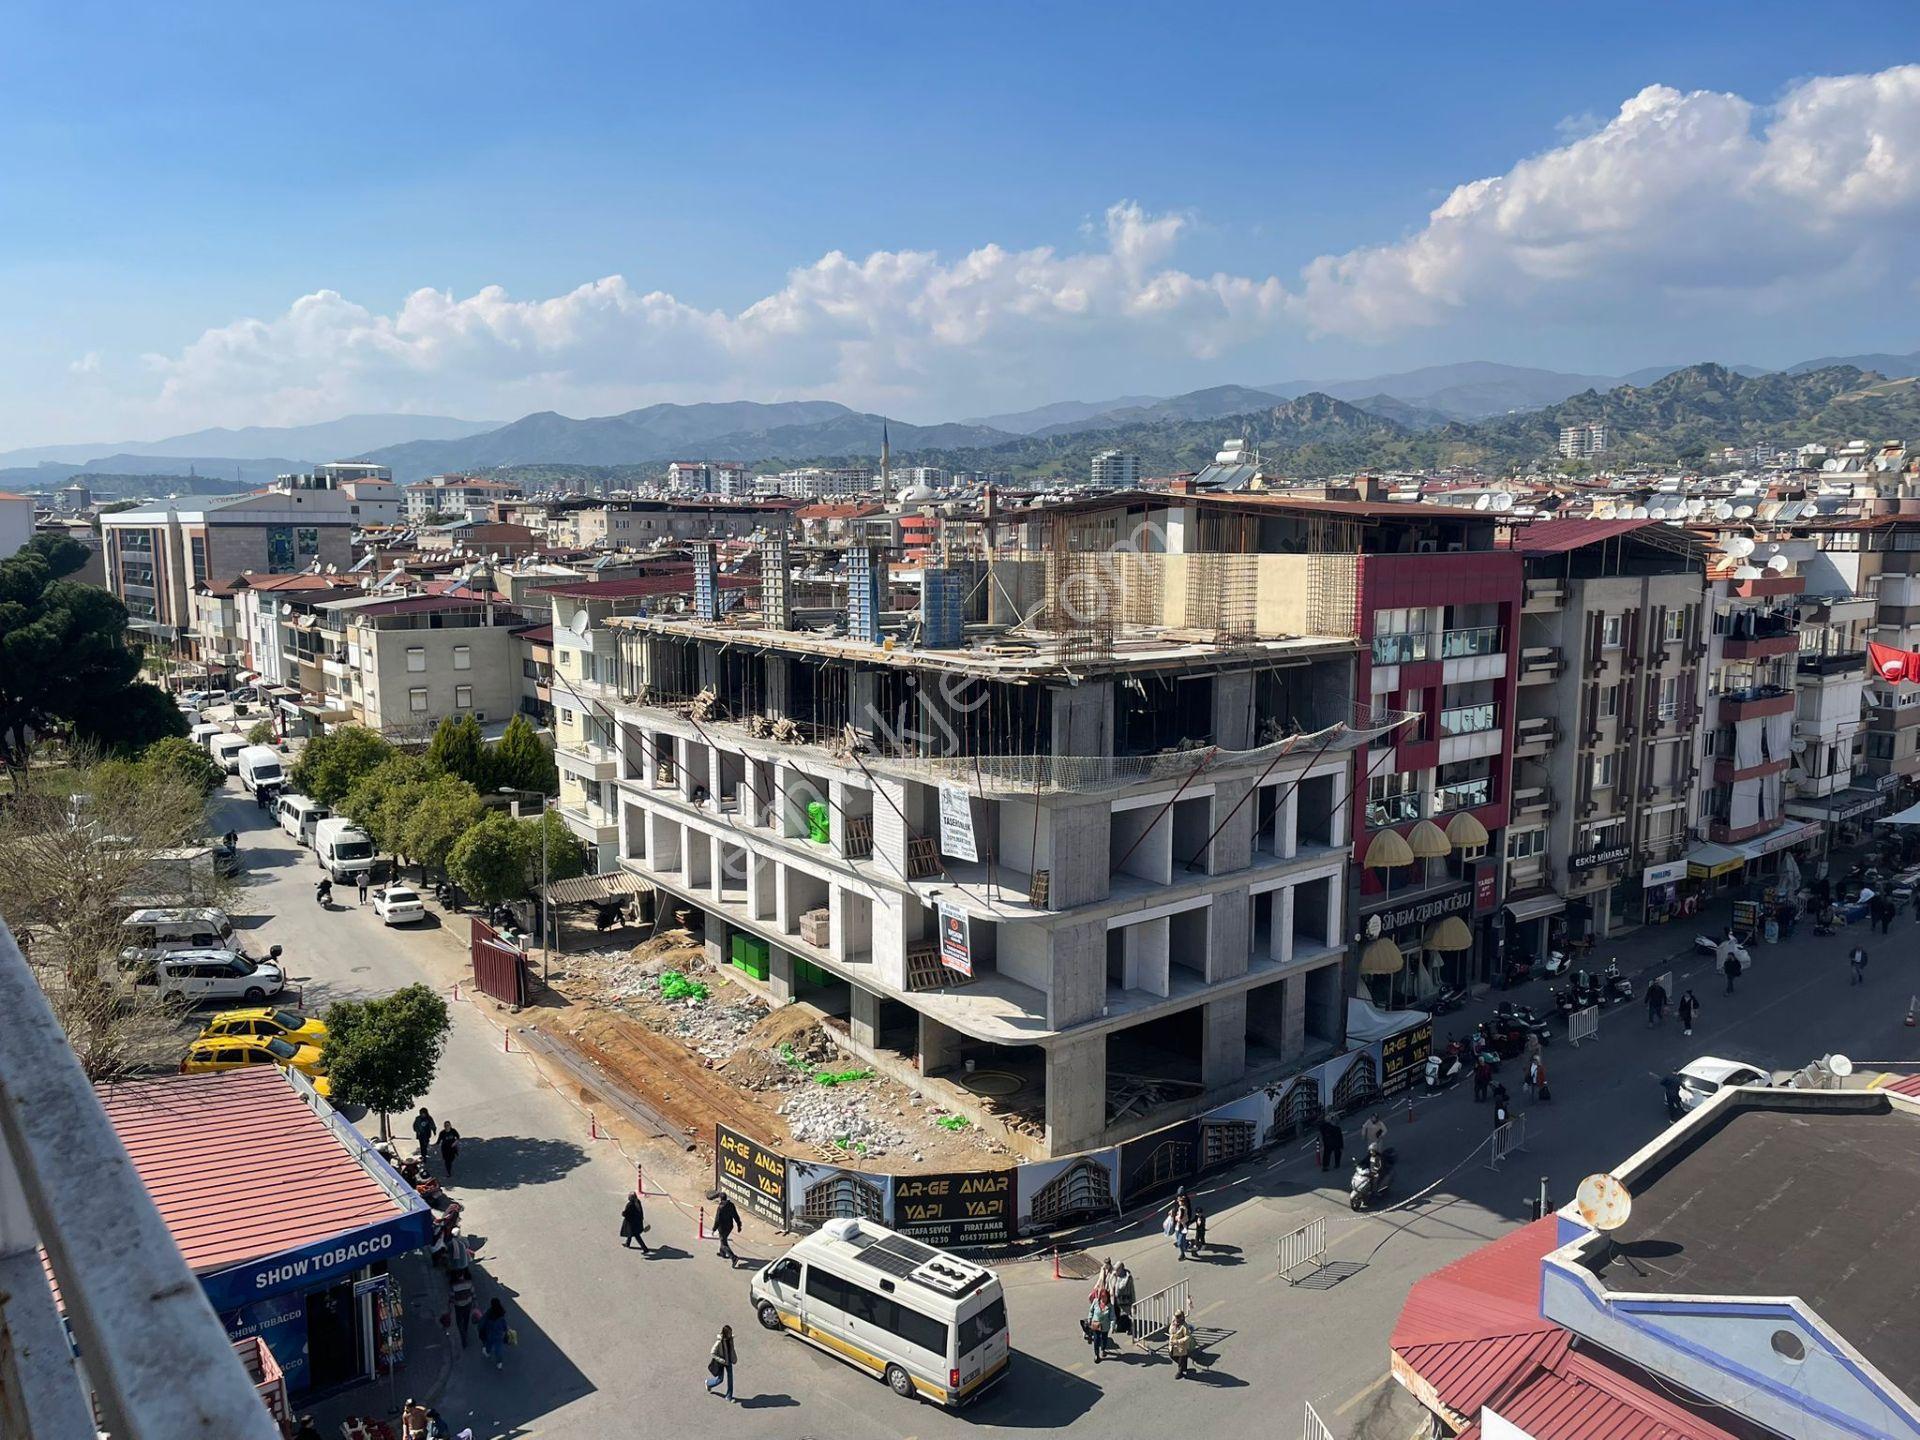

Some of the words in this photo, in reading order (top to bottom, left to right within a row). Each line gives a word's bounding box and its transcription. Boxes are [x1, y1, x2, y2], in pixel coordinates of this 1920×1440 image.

[1382, 907, 1415, 931] SİNEM
[1382, 1036, 1408, 1057] AR-GE
[720, 1134, 750, 1160] AR-GE
[724, 1156, 746, 1179] YAPI
[754, 1152, 784, 1178] ANAR
[758, 1174, 782, 1199] YAPI
[896, 1180, 951, 1197] AR-GE
[959, 1176, 1009, 1194] ANAR
[904, 1203, 943, 1220] YAPI
[965, 1199, 1004, 1216] YAPI
[896, 1227, 928, 1236] MUSTAFA
[982, 1221, 1004, 1230] ANAR
[255, 1258, 310, 1289] SHOW
[312, 1234, 392, 1271] TOBACCO
[229, 1323, 257, 1340] SHOW
[259, 1310, 302, 1330] TOBACCO
